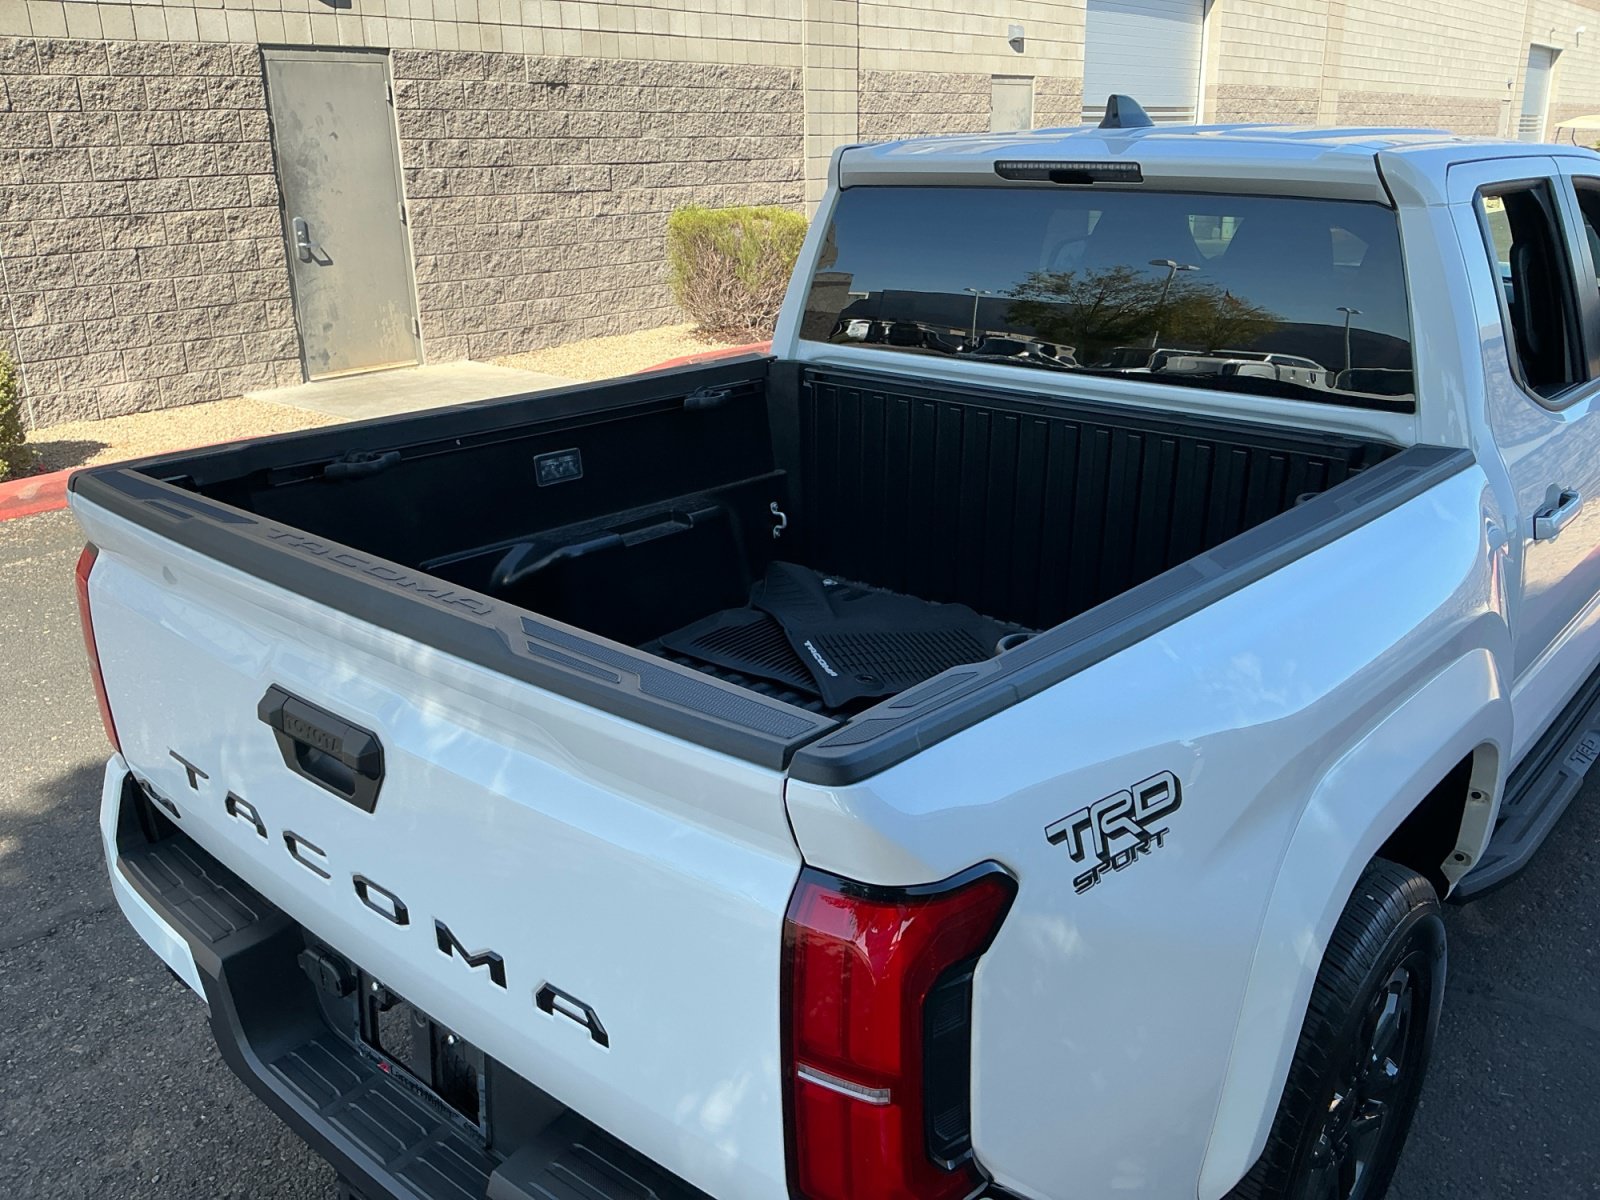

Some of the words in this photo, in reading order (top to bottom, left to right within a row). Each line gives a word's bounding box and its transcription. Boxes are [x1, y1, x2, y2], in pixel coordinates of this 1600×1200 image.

[267, 527, 492, 616] TACOMA
[804, 640, 838, 676] TACOMA
[285, 713, 338, 752] TOYOTA
[1570, 737, 1598, 764] TRD
[1045, 769, 1182, 863] TRD
[1073, 826, 1170, 895] SPORT
[168, 749, 610, 1049] TACOMA
